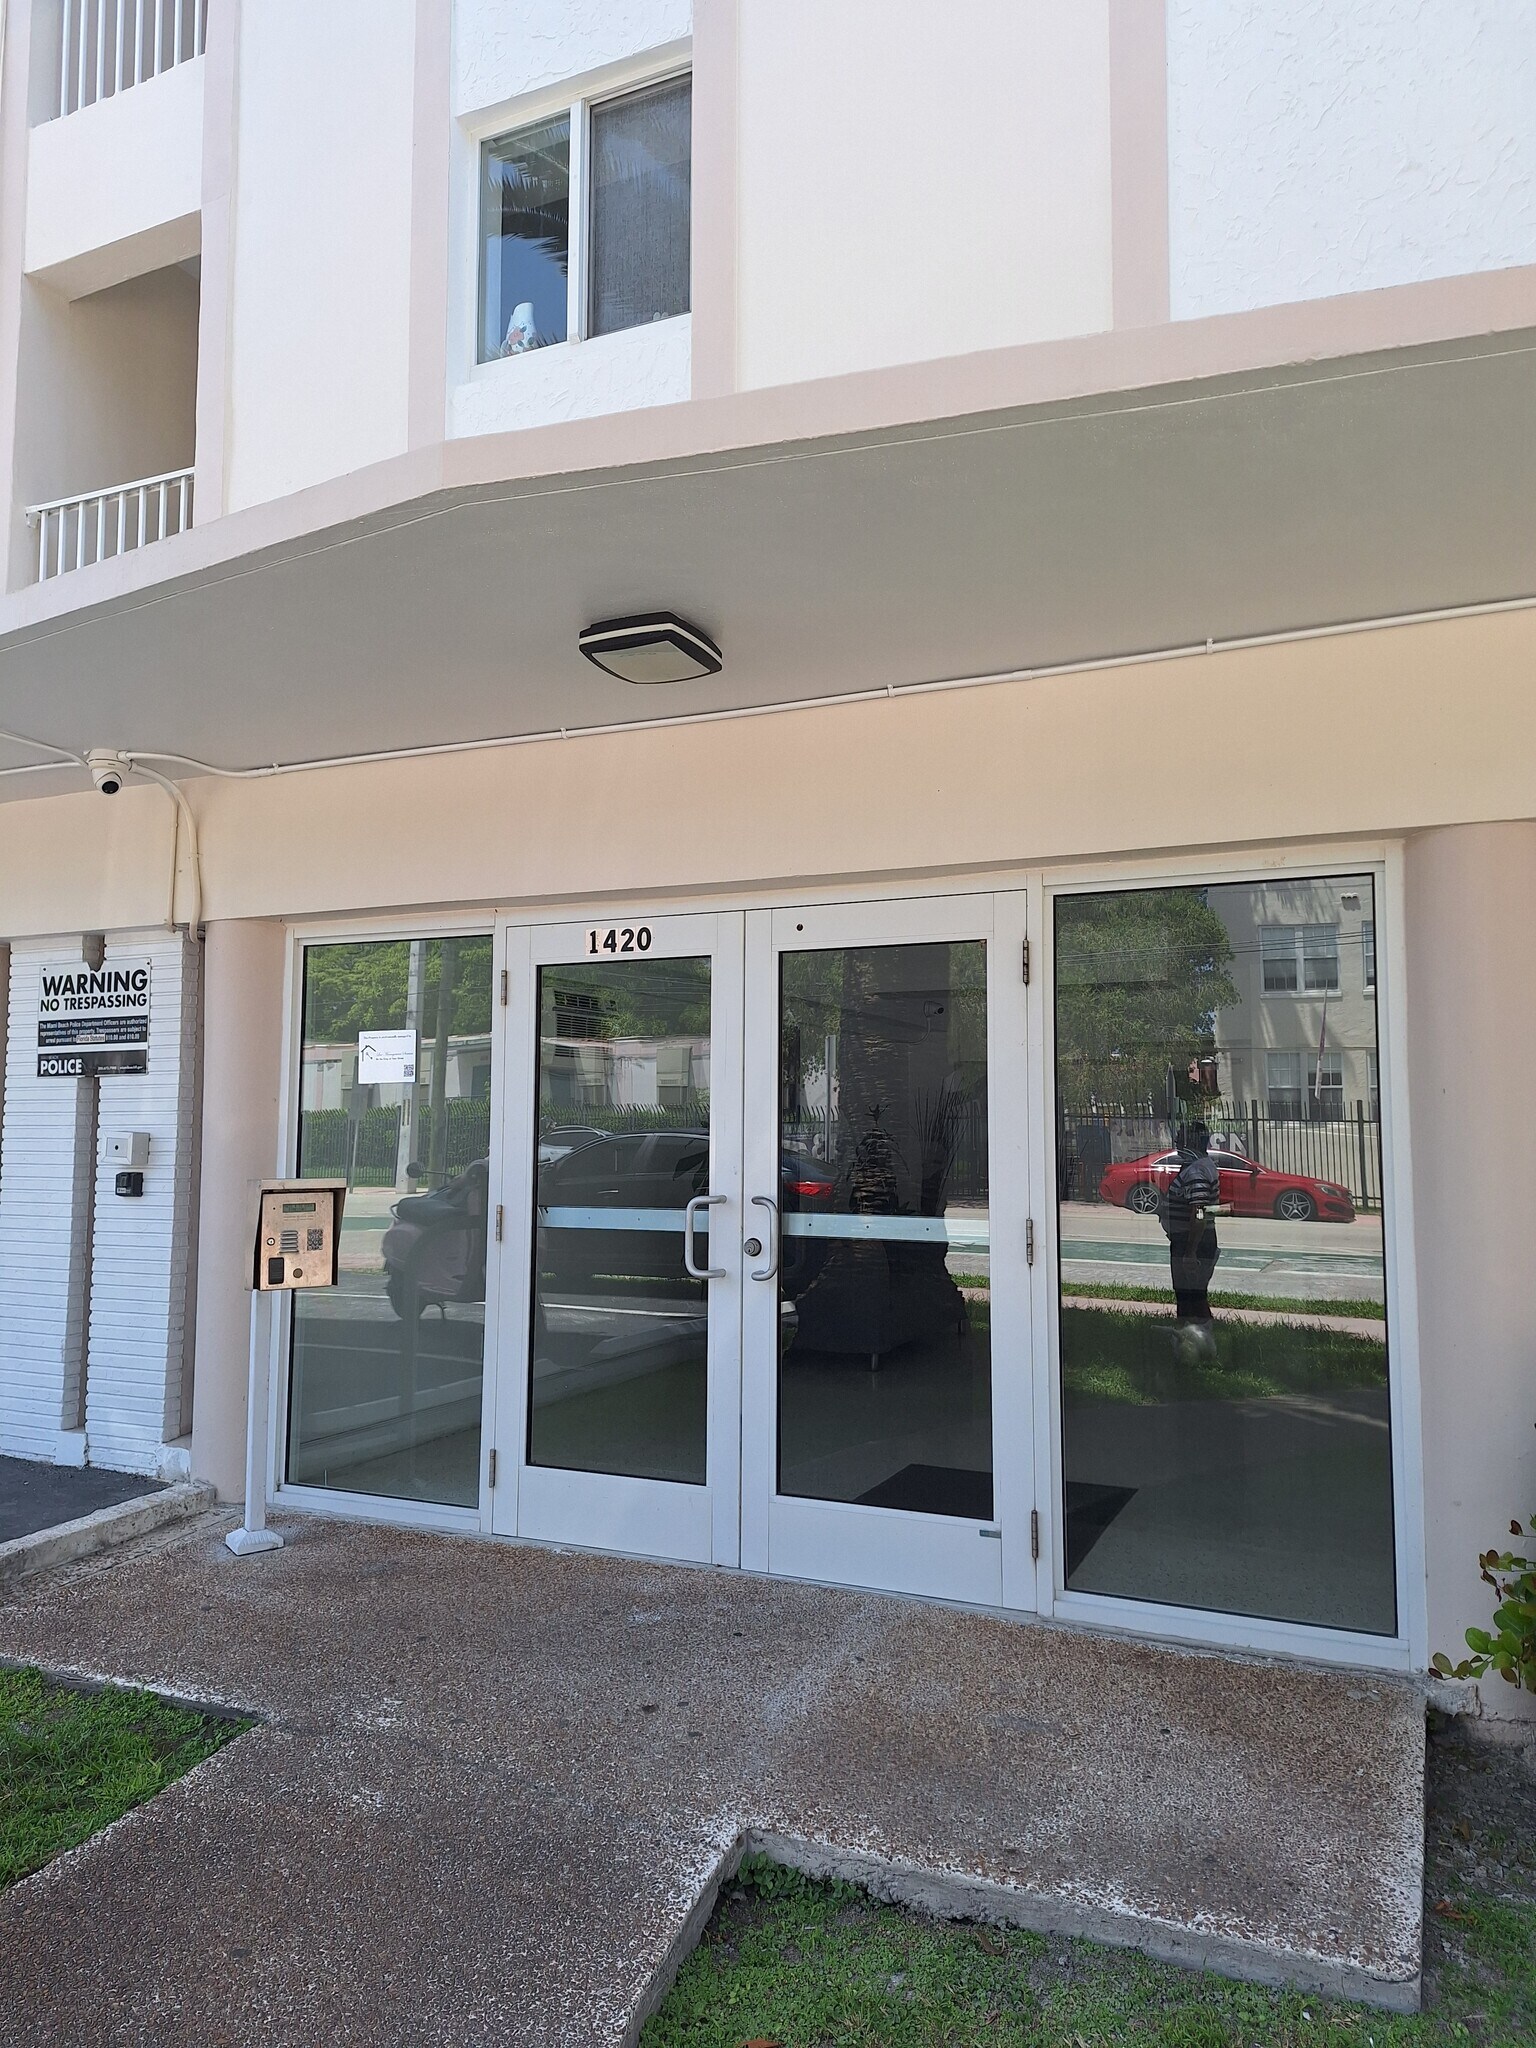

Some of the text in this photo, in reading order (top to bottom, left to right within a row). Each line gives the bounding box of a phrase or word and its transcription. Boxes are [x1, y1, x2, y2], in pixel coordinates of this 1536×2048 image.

[589, 926, 652, 954] 1420
[42, 969, 148, 997] WARNING
[40, 993, 147, 1012] NO TRESPASSING
[81, 1020, 103, 1028] Department
[40, 1059, 82, 1075] POLICE
